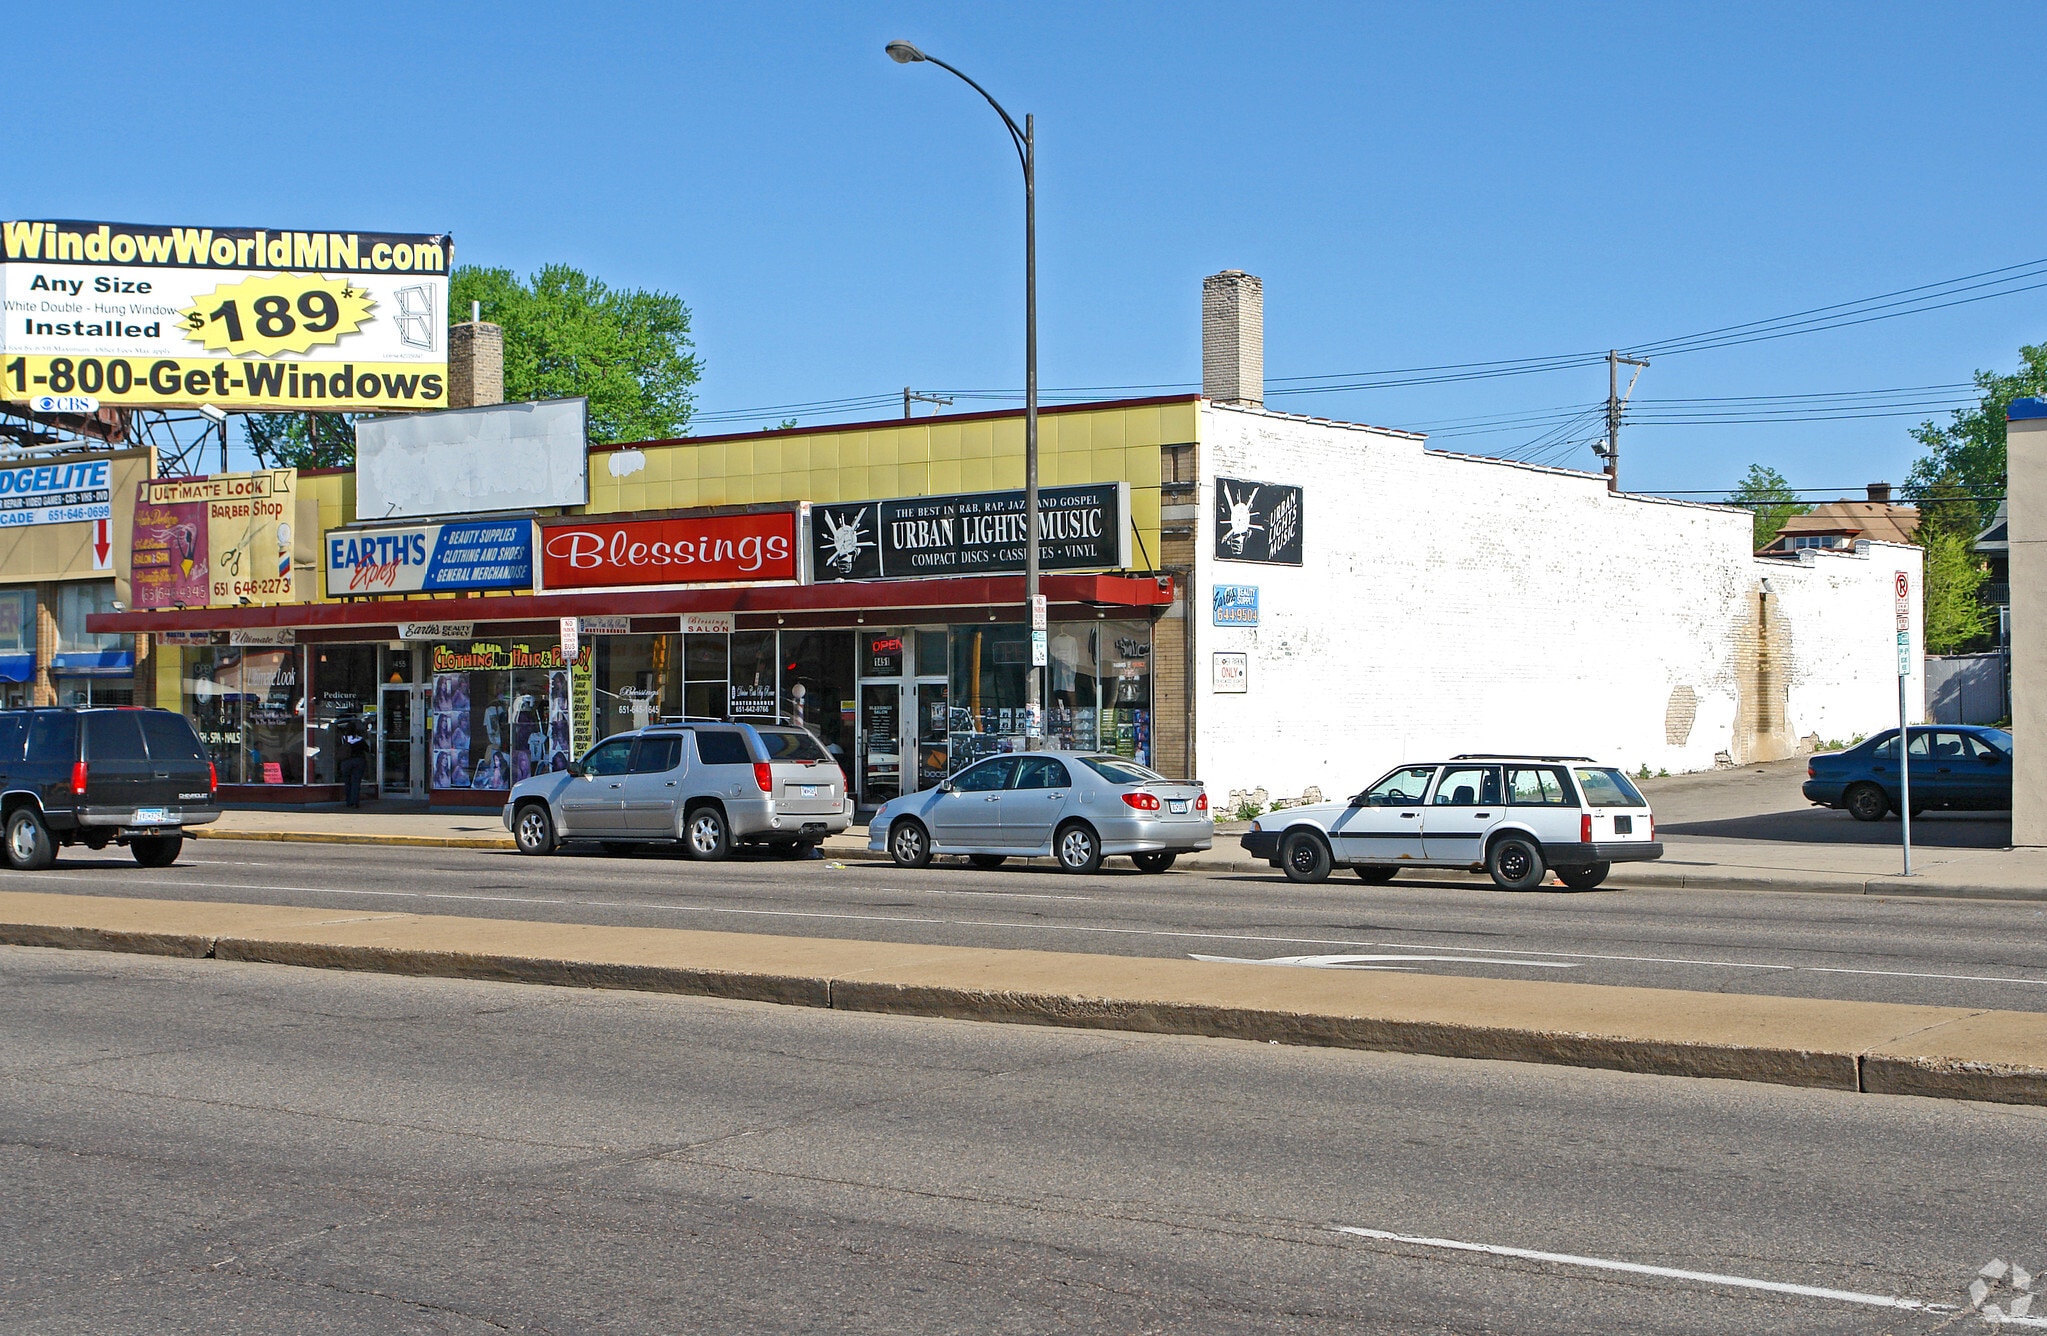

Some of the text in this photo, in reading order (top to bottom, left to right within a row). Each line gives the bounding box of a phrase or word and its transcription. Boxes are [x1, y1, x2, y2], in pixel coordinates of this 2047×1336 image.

[3, 221, 443, 271] WindowWorldMN.com
[30, 275, 152, 296] Any Size
[3, 300, 37, 312] White
[41, 301, 83, 313] Double
[95, 303, 126, 316] Hung
[130, 304, 177, 315] Window
[25, 318, 161, 338] Installed
[6, 355, 444, 401] 1-800-Get-Windows
[57, 397, 89, 411] CBS
[43, 494, 62, 506] GAMES
[896, 509, 914, 518] THE
[918, 507, 940, 517] BEST
[944, 505, 954, 515] IN
[959, 504, 980, 514] R&B,
[984, 501, 1005, 512] RAP,
[1008, 500, 1026, 510] JAZ
[1060, 495, 1099, 506] GOSPEL
[1270, 489, 1296, 527] URBAN
[48, 505, 110, 521] 651-646-0699
[211, 504, 250, 519] BARBER
[892, 508, 1103, 549] URBAN LIGHTS MUSIC
[1268, 504, 1297, 544] LIGHTS
[449, 528, 517, 544] BEAUTY SUPPLIES
[1268, 521, 1296, 560] MUSIC
[331, 533, 426, 569] EARTH'S
[443, 546, 525, 563] CLOTHING AND SHOES
[546, 530, 789, 571] Blessings
[911, 552, 956, 566] COMPACT
[961, 550, 989, 564] DISCS
[1065, 544, 1097, 557] VINYL
[350, 553, 402, 590] Express
[437, 565, 528, 582] GENERAL MERCHANDISE
[214, 582, 228, 597] 651
[1236, 596, 1255, 606] SUPPLY
[687, 616, 728, 625] Blessings
[231, 629, 273, 645] Ultimate
[405, 623, 440, 637] Earth's
[872, 638, 903, 652] OPEN
[433, 647, 493, 670] CLOTHING
[512, 648, 541, 667] HAIR
[542, 653, 551, 666] &
[277, 667, 296, 686] Look
[1221, 667, 1239, 679] ONLY
[323, 691, 357, 699] Pedicure
[620, 686, 659, 696] Blessings
[210, 732, 221, 743] SPA
[224, 732, 240, 743] NAILS
[924, 769, 947, 778] boos
